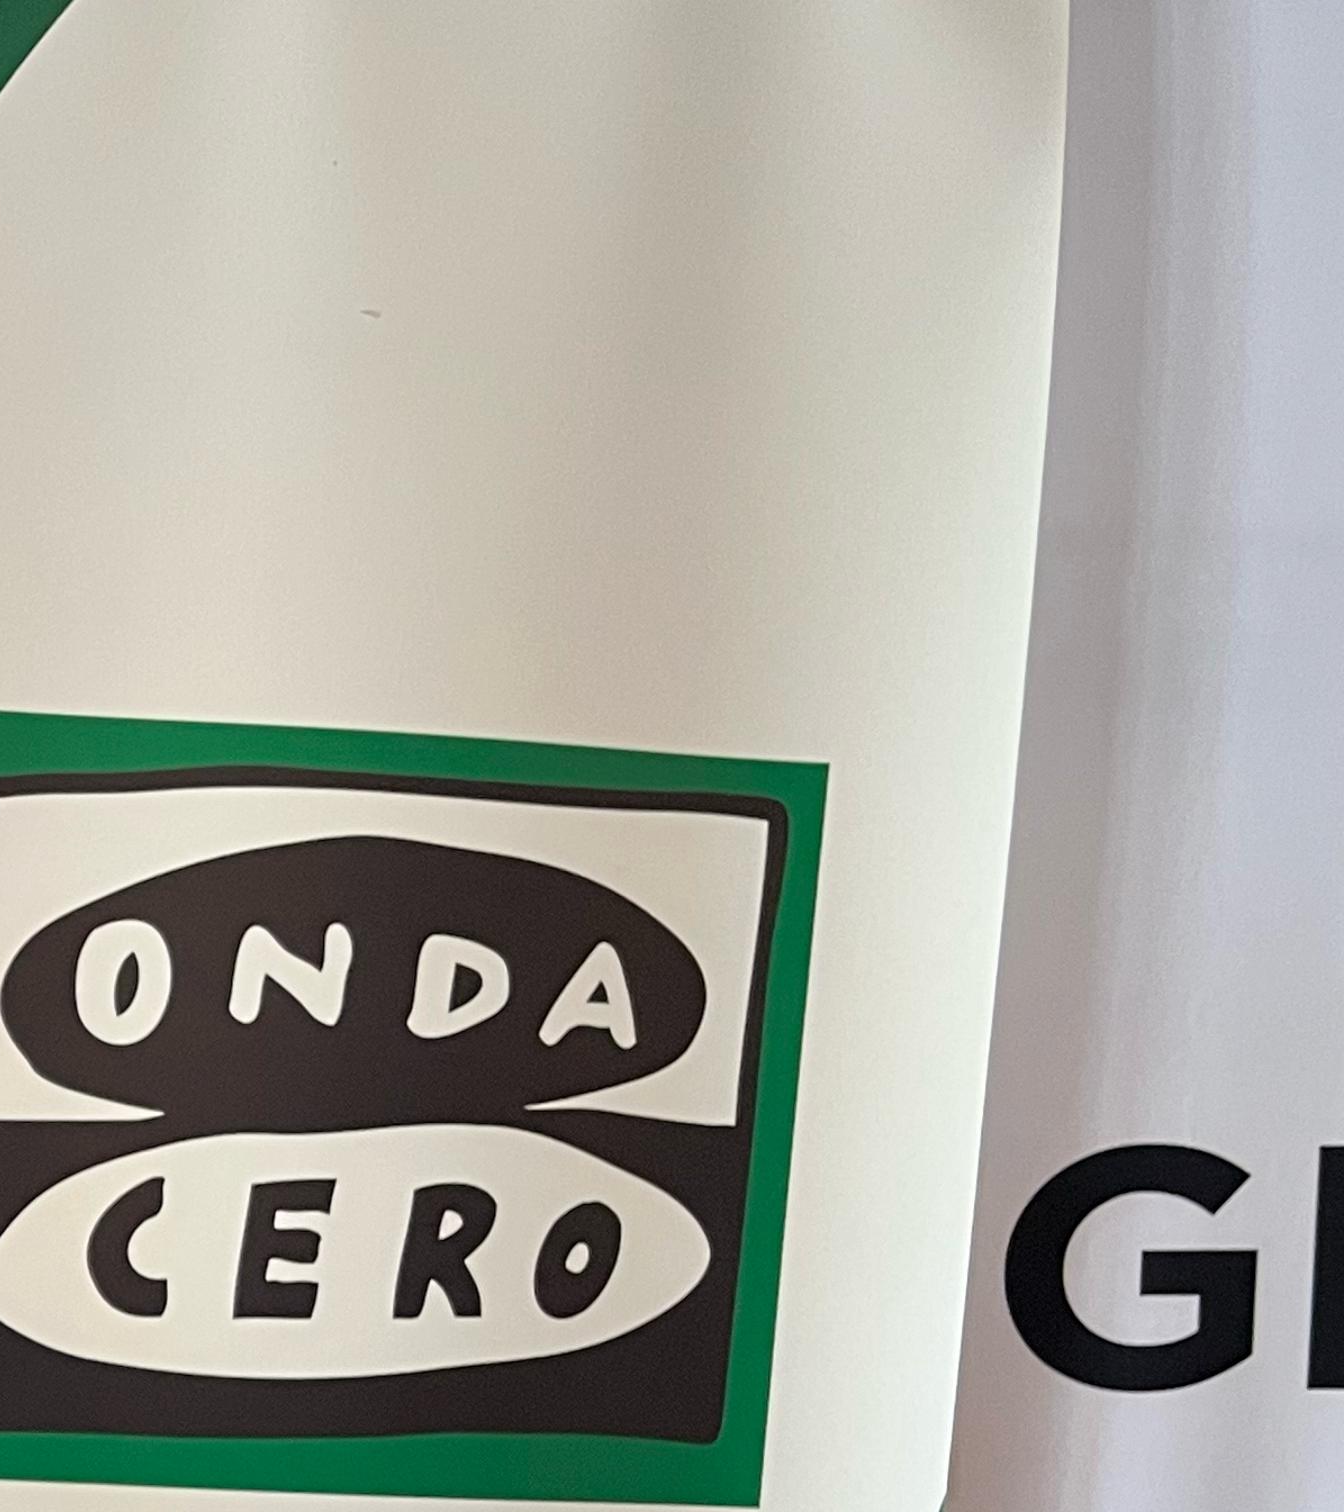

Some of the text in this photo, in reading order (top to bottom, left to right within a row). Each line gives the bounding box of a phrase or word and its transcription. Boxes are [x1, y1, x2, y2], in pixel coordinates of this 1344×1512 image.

[74, 918, 637, 1048] ONDA
[87, 1177, 622, 1319] CERO
[1005, 1143, 1344, 1391] G
